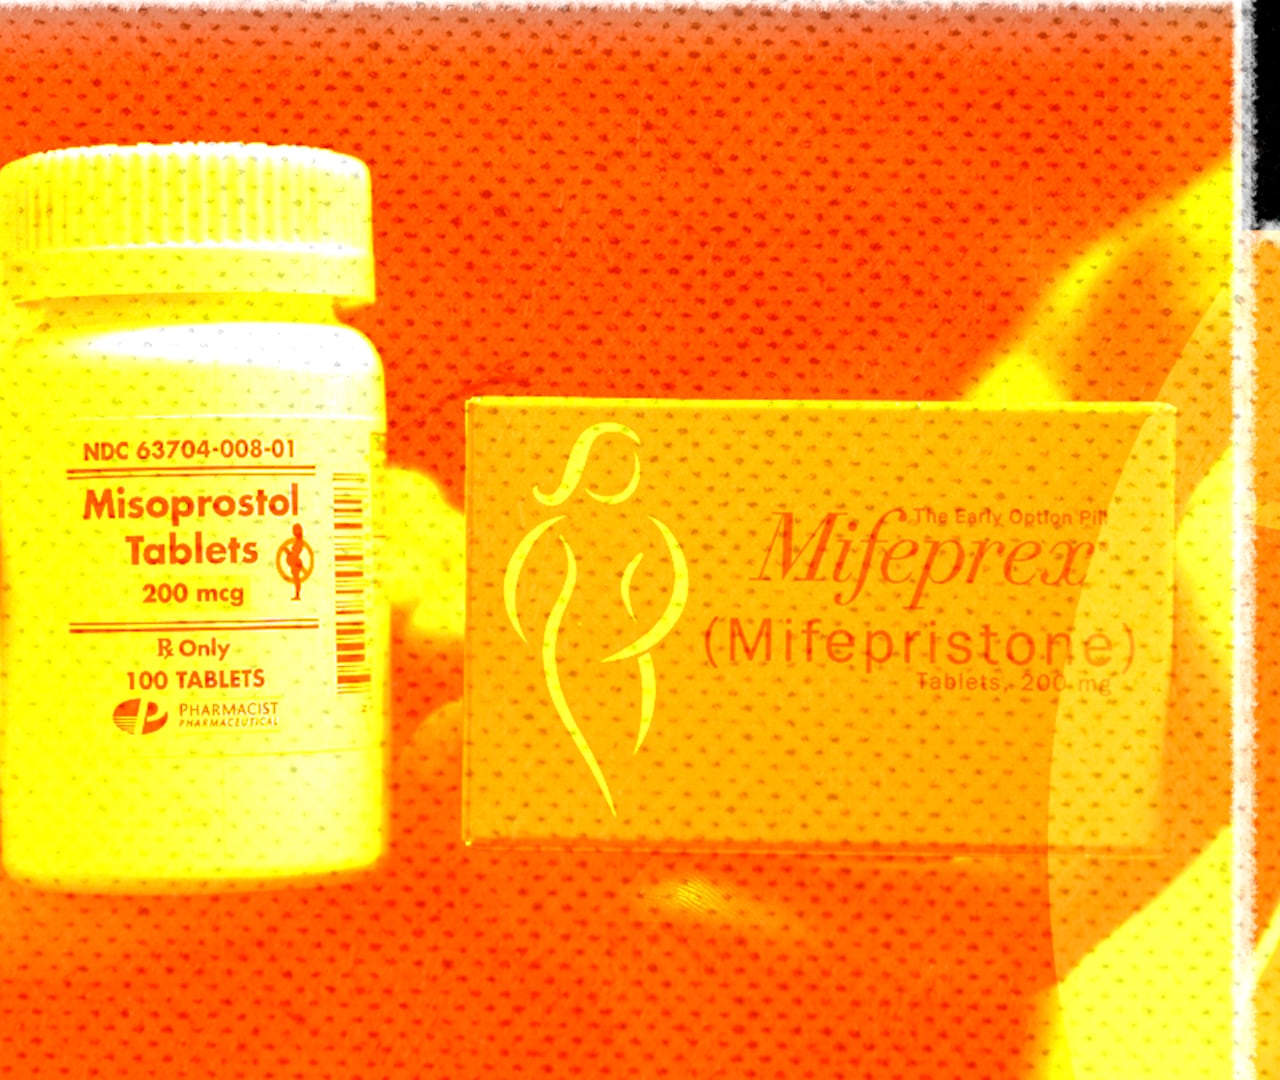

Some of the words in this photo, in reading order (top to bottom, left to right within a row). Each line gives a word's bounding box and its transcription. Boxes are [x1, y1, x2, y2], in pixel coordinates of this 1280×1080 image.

[83, 441, 129, 461] NDC
[136, 439, 295, 460] 63704-008-01
[83, 482, 299, 527] Misoprostol
[913, 508, 948, 525] The
[954, 507, 1002, 526] Early
[1009, 508, 1072, 527] Option
[125, 531, 259, 565] Tablets
[748, 507, 1095, 610] Mifeprex
[142, 583, 188, 604] 200
[196, 587, 245, 607] mcg
[179, 637, 231, 661] Only
[703, 616, 1135, 674] (Mifepristone)
[127, 670, 168, 690] 100
[176, 668, 265, 689] TABLETS
[1021, 672, 1067, 692] 200
[1078, 678, 1112, 696] mg
[179, 701, 279, 717] PHARMACIST
[178, 717, 279, 728] PHARMACEUTICAL
